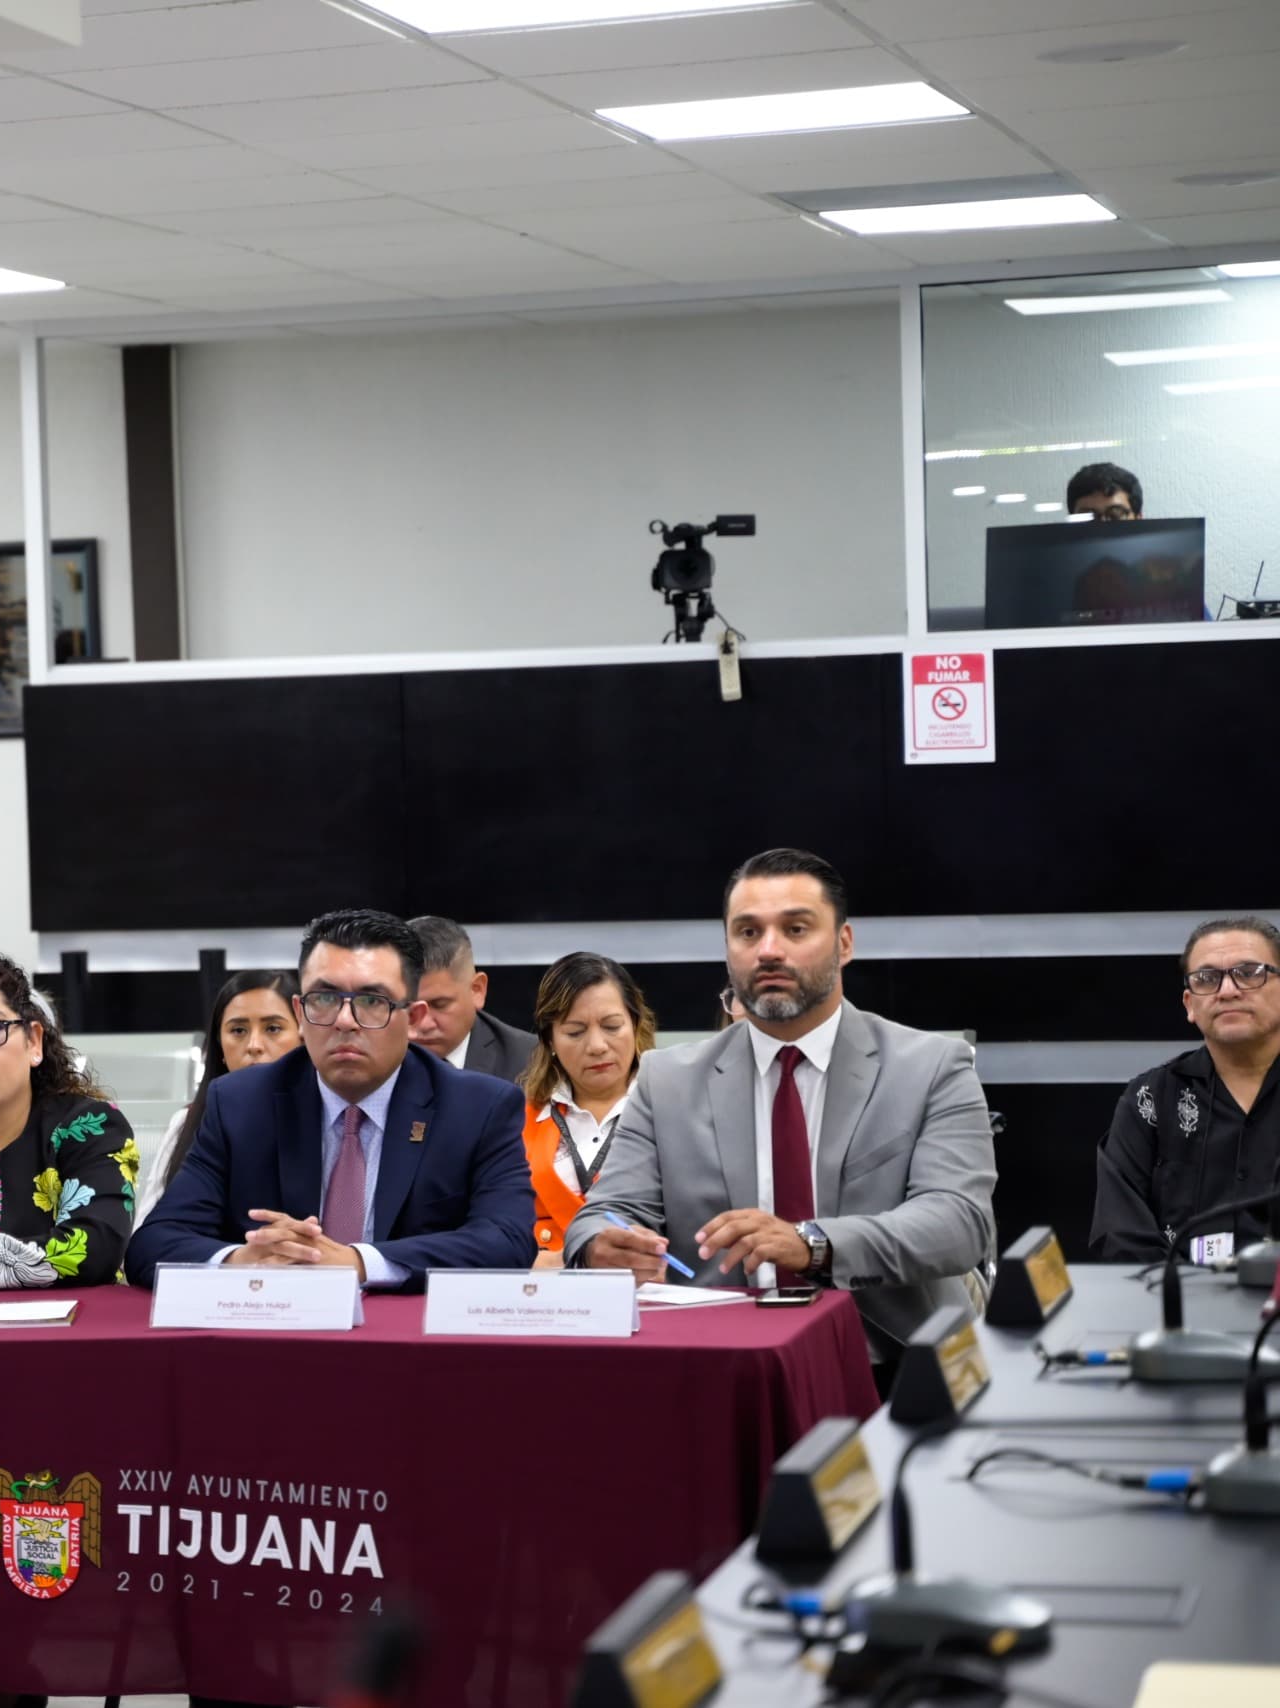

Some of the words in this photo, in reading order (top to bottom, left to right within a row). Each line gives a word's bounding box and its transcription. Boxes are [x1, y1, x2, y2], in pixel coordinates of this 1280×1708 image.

[936, 655, 962, 670] NO
[928, 670, 971, 682] FUMAR
[217, 1301, 241, 1309] Pedro
[485, 1306, 515, 1314] Alberto
[118, 1469, 172, 1492] XXIV
[187, 1473, 388, 1512] AYUNTAMIENTO
[13, 1505, 69, 1517] TIJUANA
[117, 1503, 384, 1579] TIJUANA
[23, 1544, 59, 1553] JUSTICIA
[4, 1557, 51, 1599] EMPIEZA
[56, 1577, 74, 1593] LA
[71, 1517, 81, 1568] PATRIA
[26, 1552, 57, 1560] SOCIAL
